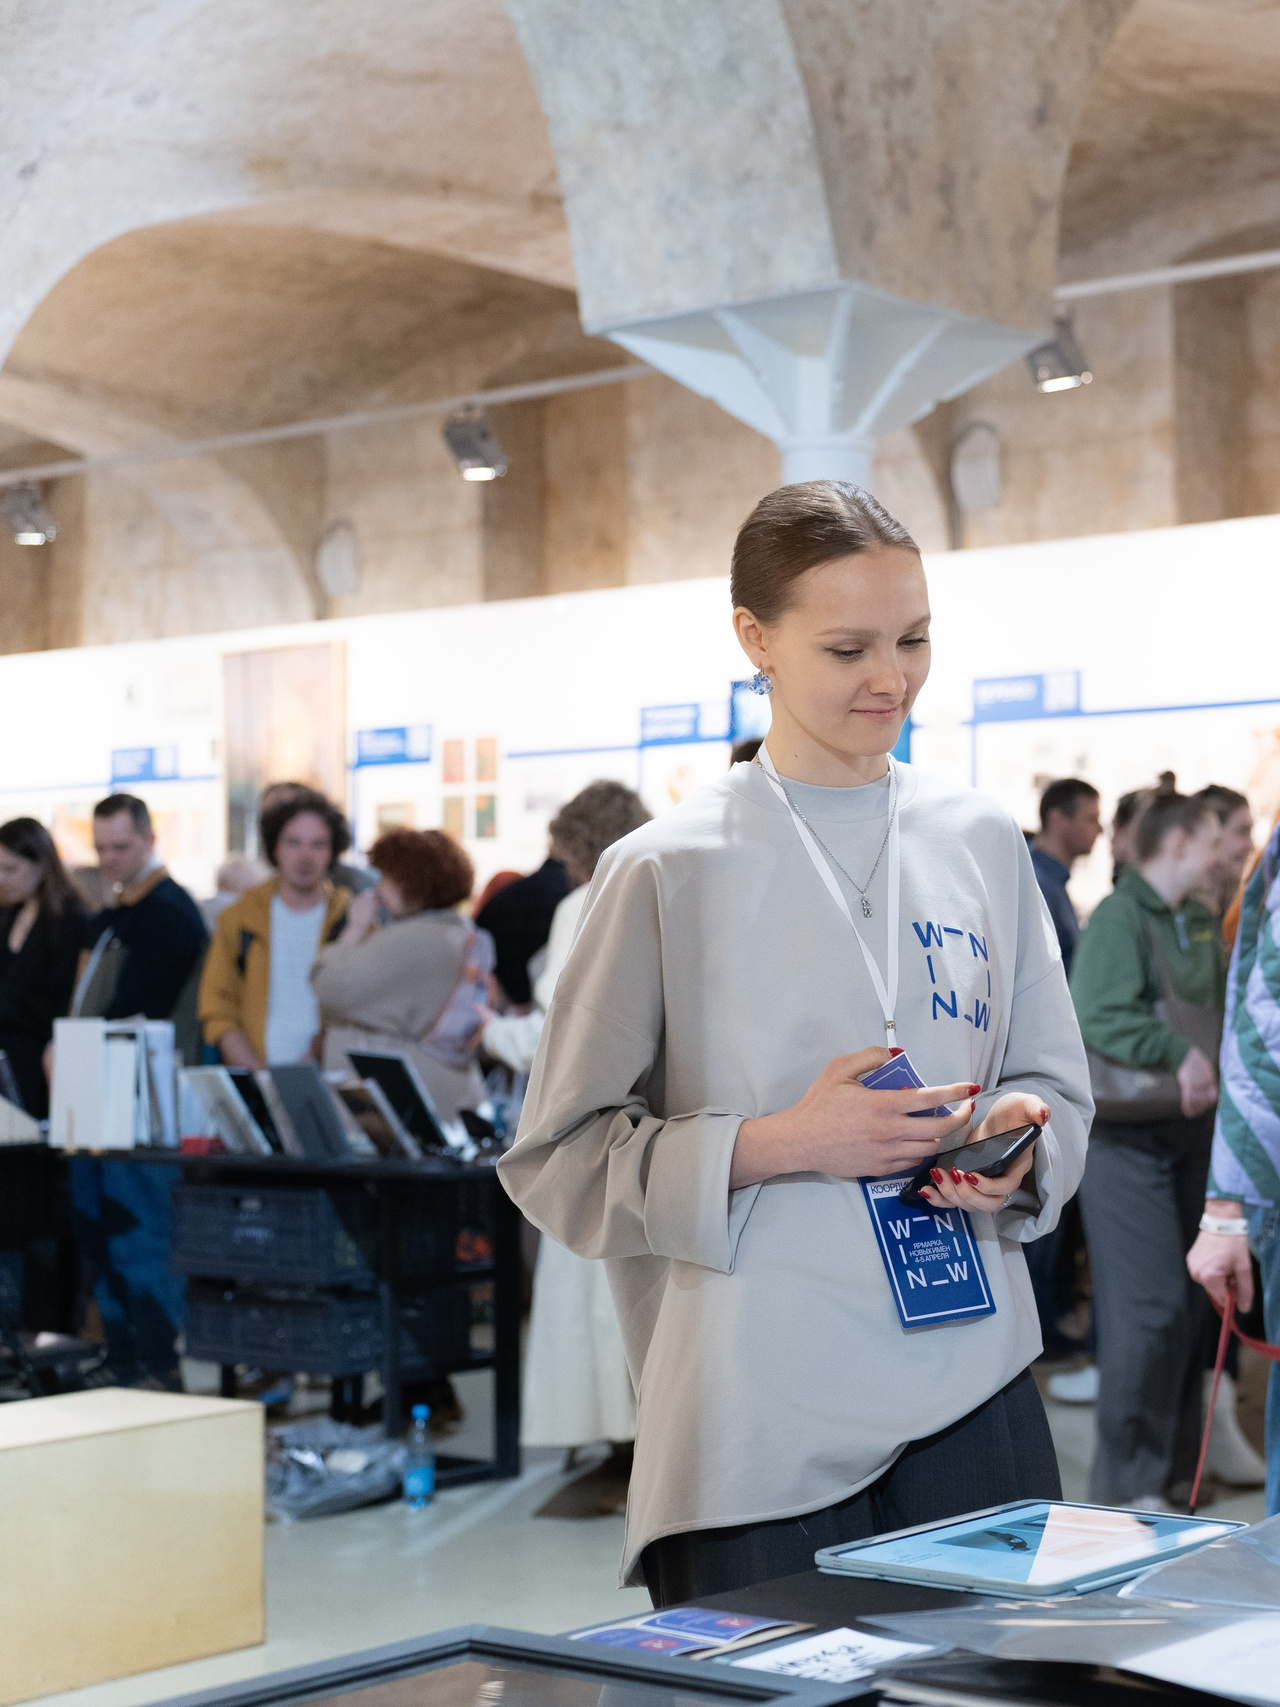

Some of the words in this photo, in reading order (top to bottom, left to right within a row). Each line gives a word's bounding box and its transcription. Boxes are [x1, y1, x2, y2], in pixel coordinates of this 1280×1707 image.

[870, 1181, 909, 1195] КООРДИ
[912, 1239, 943, 1249] ЯРМАРКА
[909, 1248, 932, 1257] НОВЫХ
[932, 1244, 951, 1254] ИМЕН
[925, 1252, 950, 1262] АПРЕЛЯ
